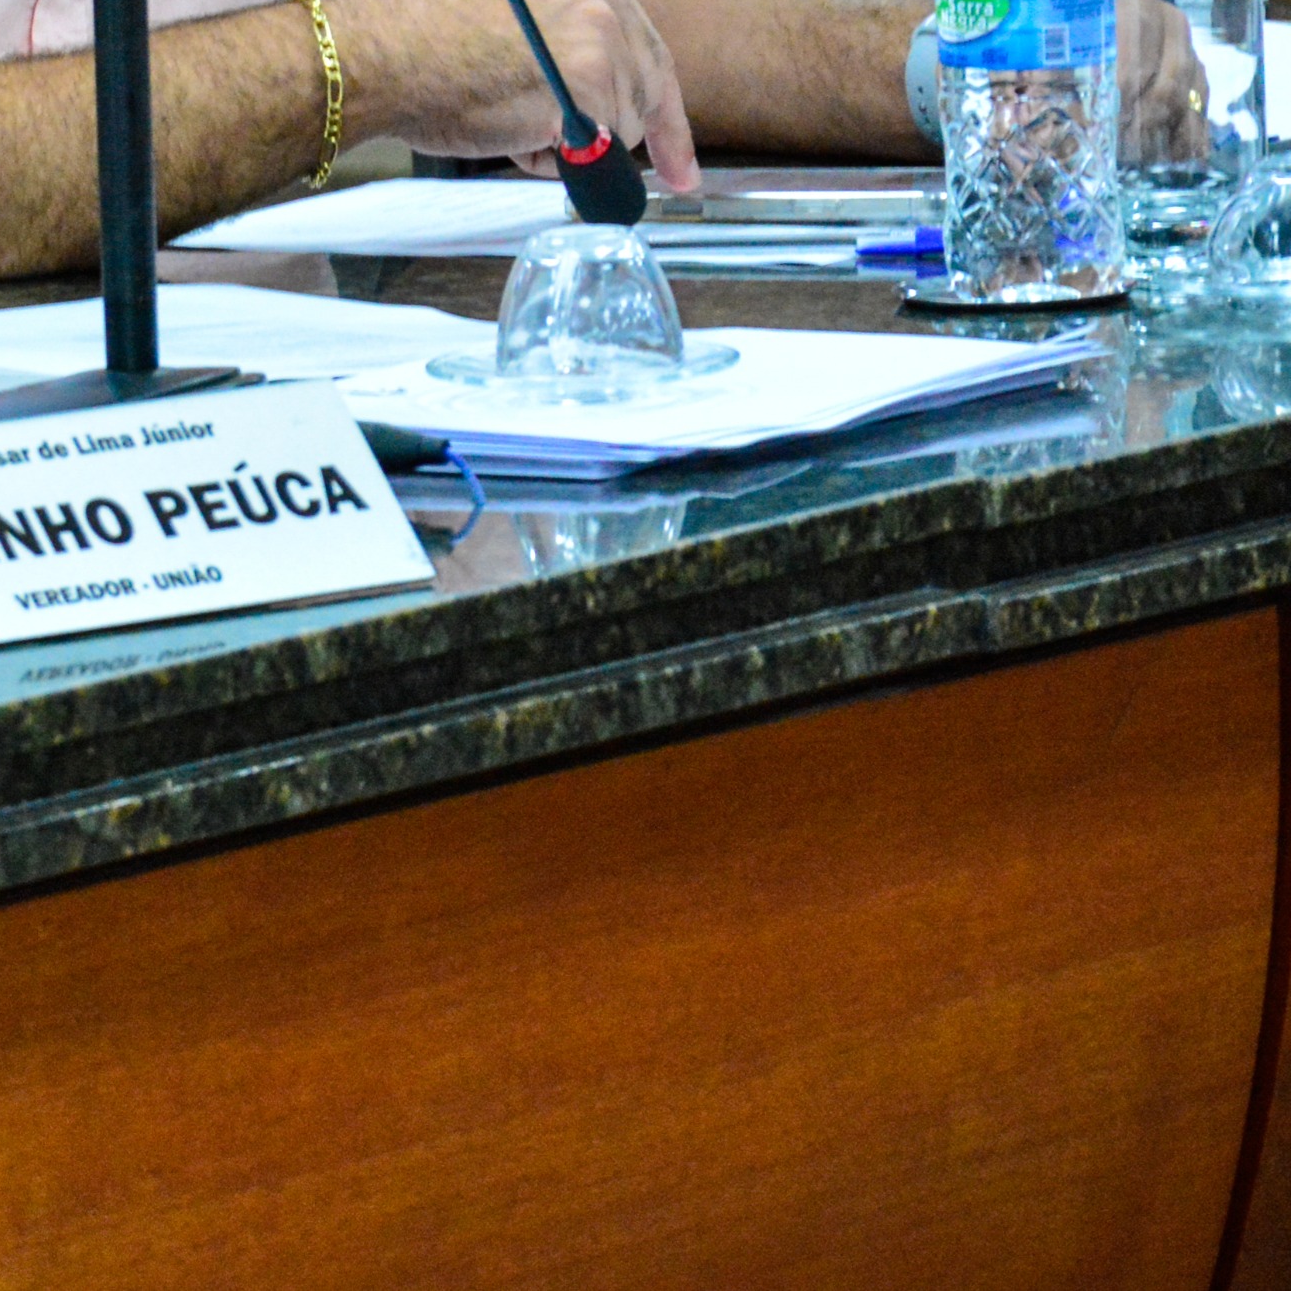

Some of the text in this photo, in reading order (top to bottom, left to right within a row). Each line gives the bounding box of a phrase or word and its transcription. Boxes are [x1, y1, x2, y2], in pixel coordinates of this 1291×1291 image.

[37, 440, 70, 461] de
[72, 433, 136, 455] Lima
[141, 421, 216, 446] Júnior
[143, 460, 371, 539] PEÚCA
[14, 578, 138, 610] VEREADOR
[151, 563, 223, 591] UNIÃO
